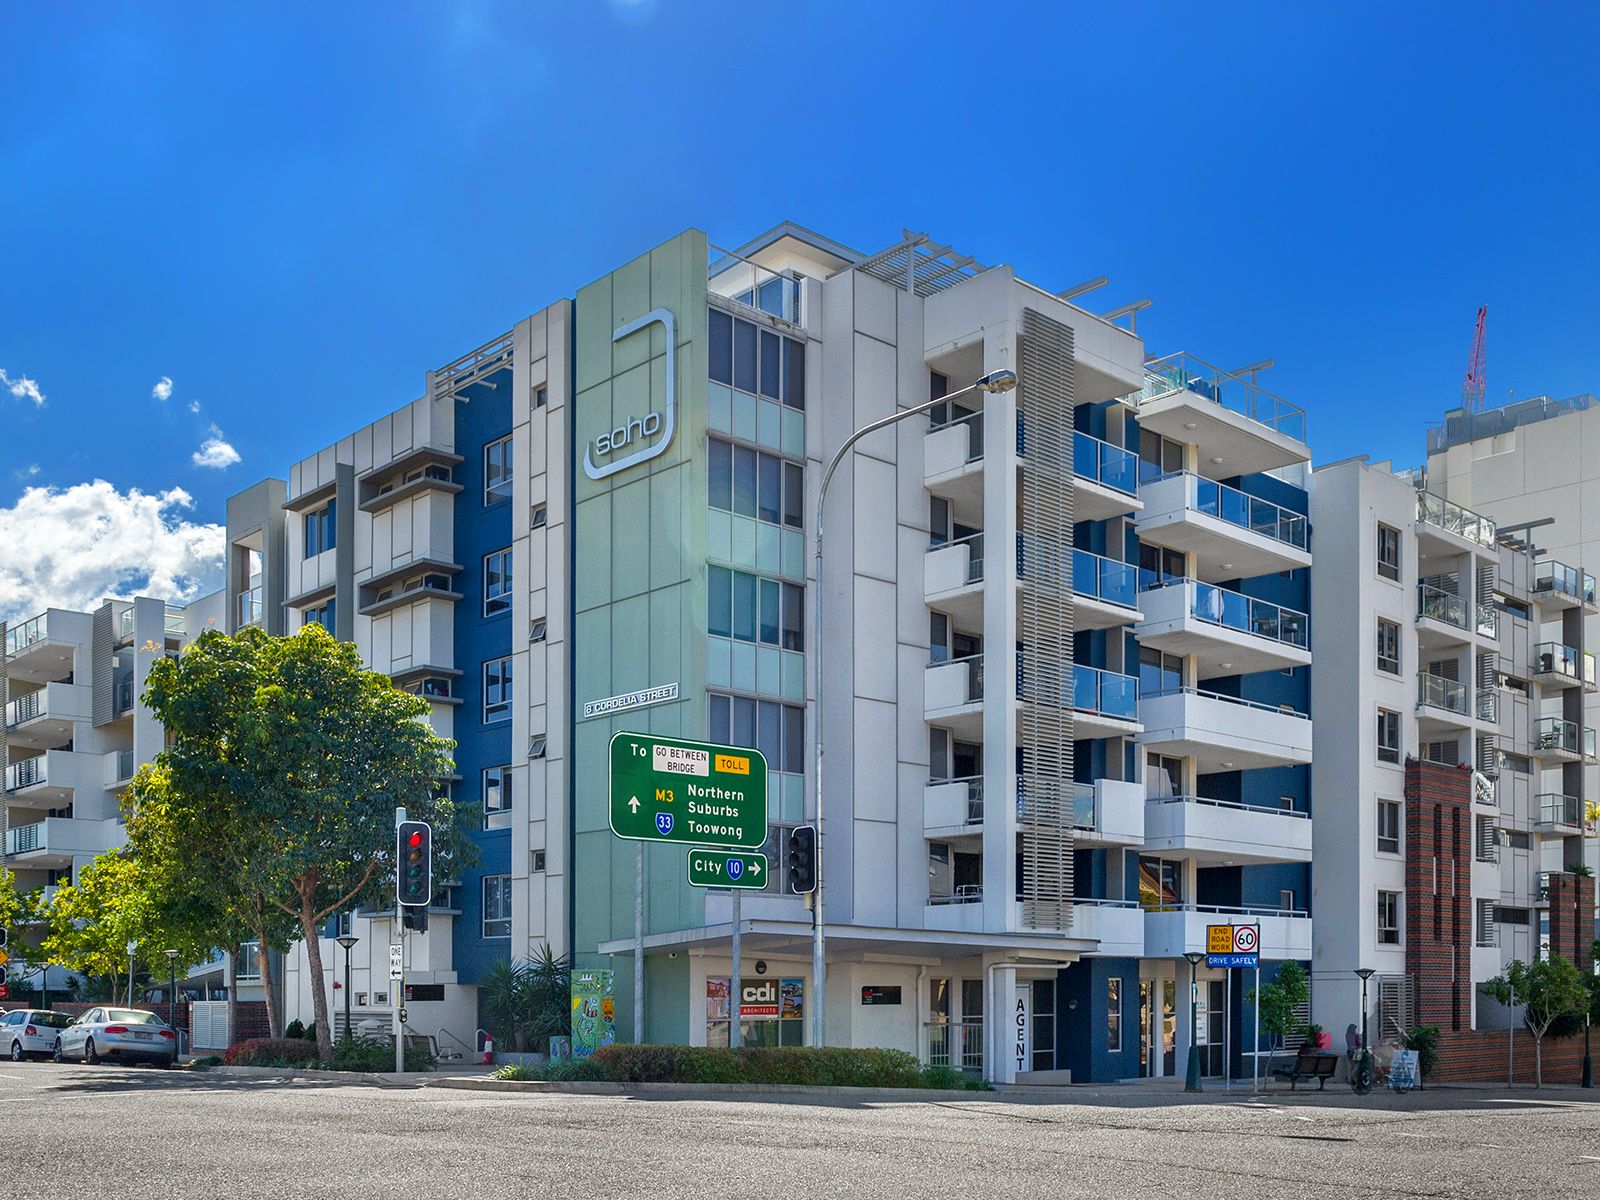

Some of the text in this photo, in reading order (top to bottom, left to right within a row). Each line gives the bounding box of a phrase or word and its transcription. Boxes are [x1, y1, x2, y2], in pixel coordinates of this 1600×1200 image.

[595, 411, 661, 456] soho
[594, 695, 638, 712] CORDELIA
[639, 686, 676, 702] STREET
[630, 743, 647, 757] To
[655, 746, 707, 762] GO BETWEEN
[667, 761, 695, 774] BRIDGE
[721, 759, 744, 771] TOLL
[655, 788, 674, 802] M3
[687, 783, 744, 802] Northern
[687, 801, 739, 818] Suburbs
[658, 815, 671, 829] 33
[687, 820, 743, 840] Toowong
[694, 859, 740, 876] City 10
[1213, 927, 1228, 935] END
[1237, 933, 1254, 945] 60
[391, 947, 401, 956] ONE
[391, 959, 402, 967] WAY
[1208, 957, 1257, 965] DRIVE SAFELY
[743, 980, 775, 1002] cdi
[1015, 998, 1025, 1071] AGENT
